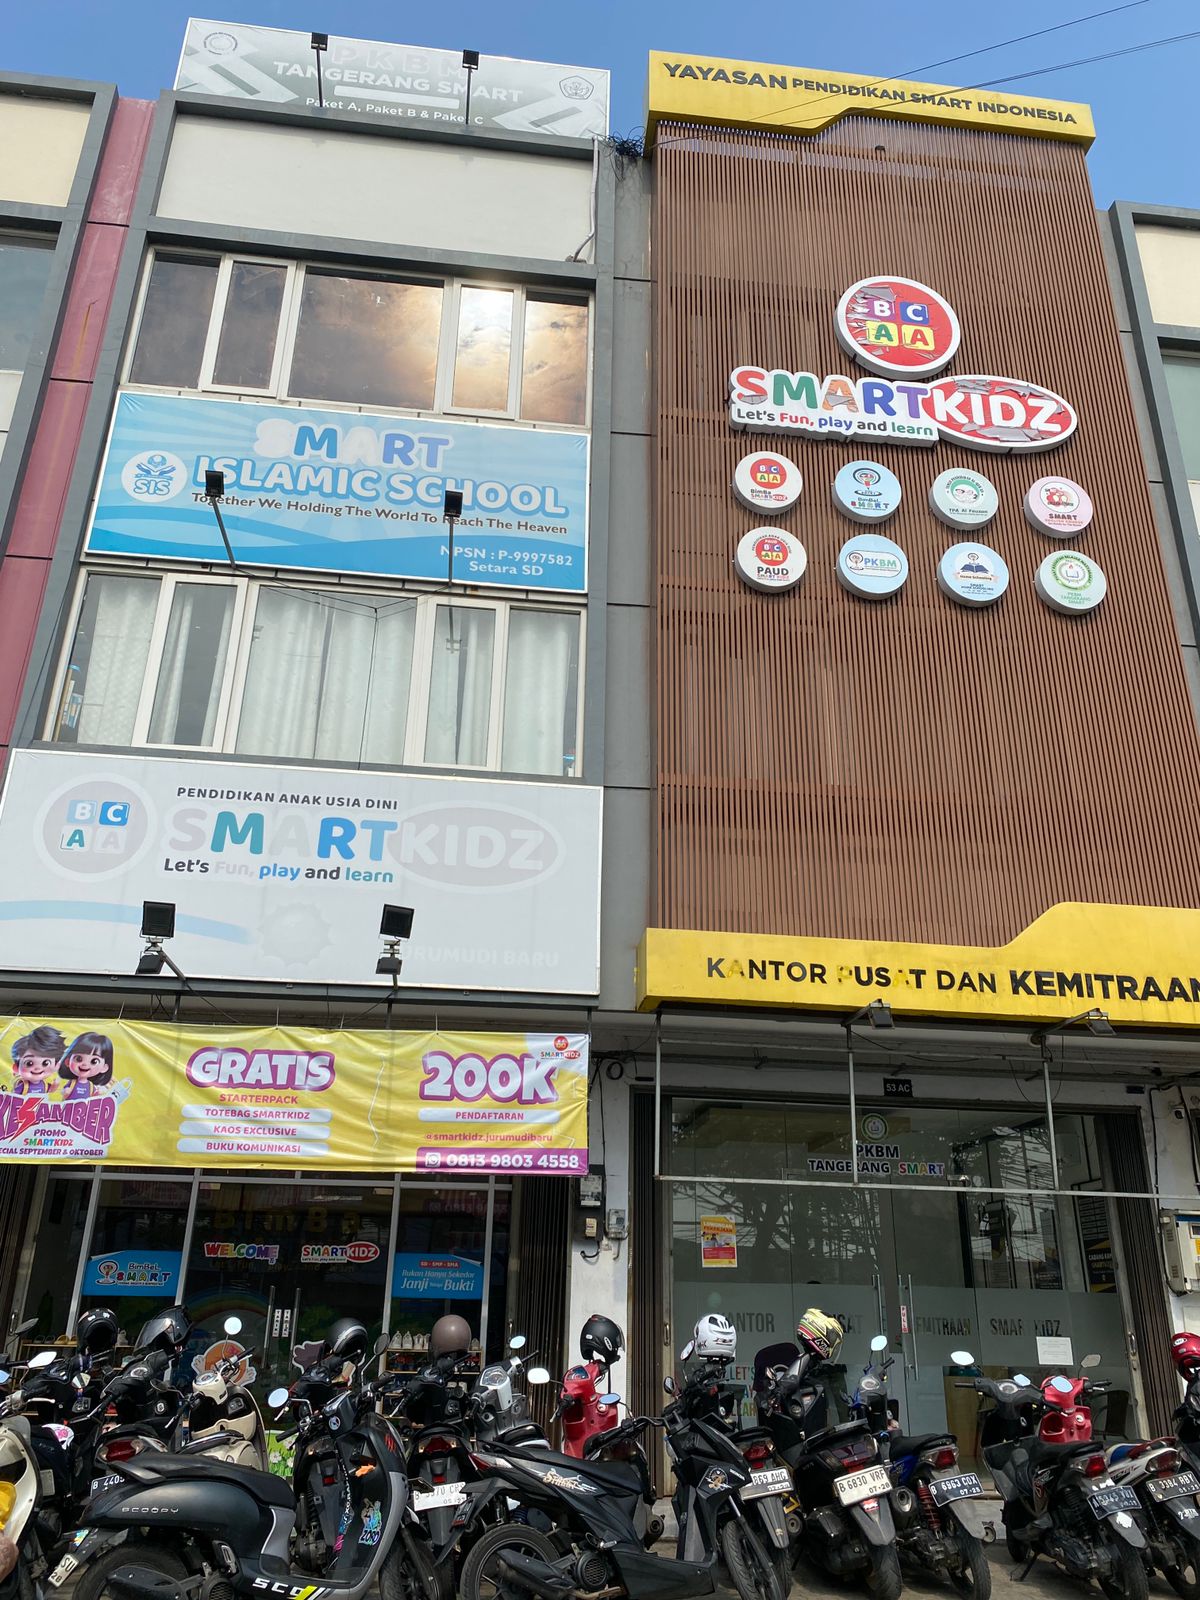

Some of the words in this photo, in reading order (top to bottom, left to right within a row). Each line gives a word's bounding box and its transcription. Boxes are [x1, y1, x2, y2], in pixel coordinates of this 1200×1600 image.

[273, 61, 431, 91] TANGERANG
[437, 81, 524, 102] SMART
[662, 62, 788, 89] YAYASAN
[792, 78, 906, 101] PENDIDIKAN
[911, 92, 972, 110] SMART
[977, 101, 1078, 124] INDONESIA
[306, 97, 344, 109] Paket
[347, 102, 361, 112] A,
[366, 103, 403, 116] Paket
[407, 108, 416, 117] B
[420, 109, 429, 119] &
[434, 111, 471, 123] Pake
[475, 116, 484, 125] C
[779, 412, 814, 427] Fun,
[817, 416, 853, 437] play
[857, 418, 888, 433] and
[891, 421, 934, 437] learn
[133, 478, 170, 496] SIS
[194, 455, 379, 498] ISLAMIC
[387, 471, 569, 518] SCHOOL
[258, 498, 282, 510] We
[287, 500, 342, 517] Holding
[345, 505, 372, 517] The
[375, 508, 419, 523] World
[421, 512, 438, 524] To
[442, 514, 483, 528] Reach
[486, 518, 513, 530] The
[517, 520, 567, 534] Heaven
[440, 544, 487, 561] NPSN
[498, 549, 573, 566] P-9997582
[864, 557, 897, 567] PKBM
[469, 561, 519, 577] Setara
[523, 564, 544, 577] SD
[757, 566, 789, 576] PAUD
[176, 786, 276, 802] PENDIDIKAN
[278, 793, 322, 806] ANAK
[325, 795, 361, 808] USIA
[364, 798, 399, 811] DINI
[163, 857, 209, 875] Let's
[214, 860, 255, 880] Fun,
[259, 862, 300, 882] play
[305, 864, 341, 881] and
[345, 866, 394, 883] learn
[396, 945, 497, 965] URUMUDI
[503, 948, 560, 969] BARU
[707, 956, 827, 985] KANTOR
[937, 970, 997, 994] DAN
[188, 1050, 333, 1090] GRATIS
[422, 1053, 557, 1102] 200K
[886, 1083, 897, 1092] 53
[898, 1084, 910, 1093] AC
[219, 1092, 298, 1105] STARTERPACK
[204, 1108, 251, 1119] TOTEBAG
[252, 1109, 310, 1120] SMARTKIDZ
[455, 1111, 524, 1121] PENDAFTARAN
[34, 1128, 67, 1137] PROMO
[213, 1124, 241, 1135] KAOS
[243, 1125, 297, 1137] EXCLUSIVE
[23, 1138, 74, 1147] SMARTKIDZ
[206, 1141, 235, 1152] BUKU
[236, 1142, 301, 1154] KOMUNIKASI
[856, 1144, 900, 1158] PKBM
[19, 1147, 64, 1156] SEPTEMBER
[69, 1148, 104, 1157] OKTOBER
[446, 1154, 485, 1167] 0813
[491, 1154, 533, 1168] 9803
[537, 1154, 579, 1169] 4558
[808, 1159, 890, 1175] TANGERANG
[898, 1162, 945, 1177] SMART
[205, 1243, 279, 1258] WELCOME
[117, 1272, 171, 1282] SMART
[401, 1278, 429, 1292] Janji
[443, 1279, 475, 1292] Bukti
[722, 1311, 775, 1333] ANTOR
[839, 1482, 846, 1494] B
[847, 1475, 868, 1491] 6830
[870, 1469, 886, 1483] VRF
